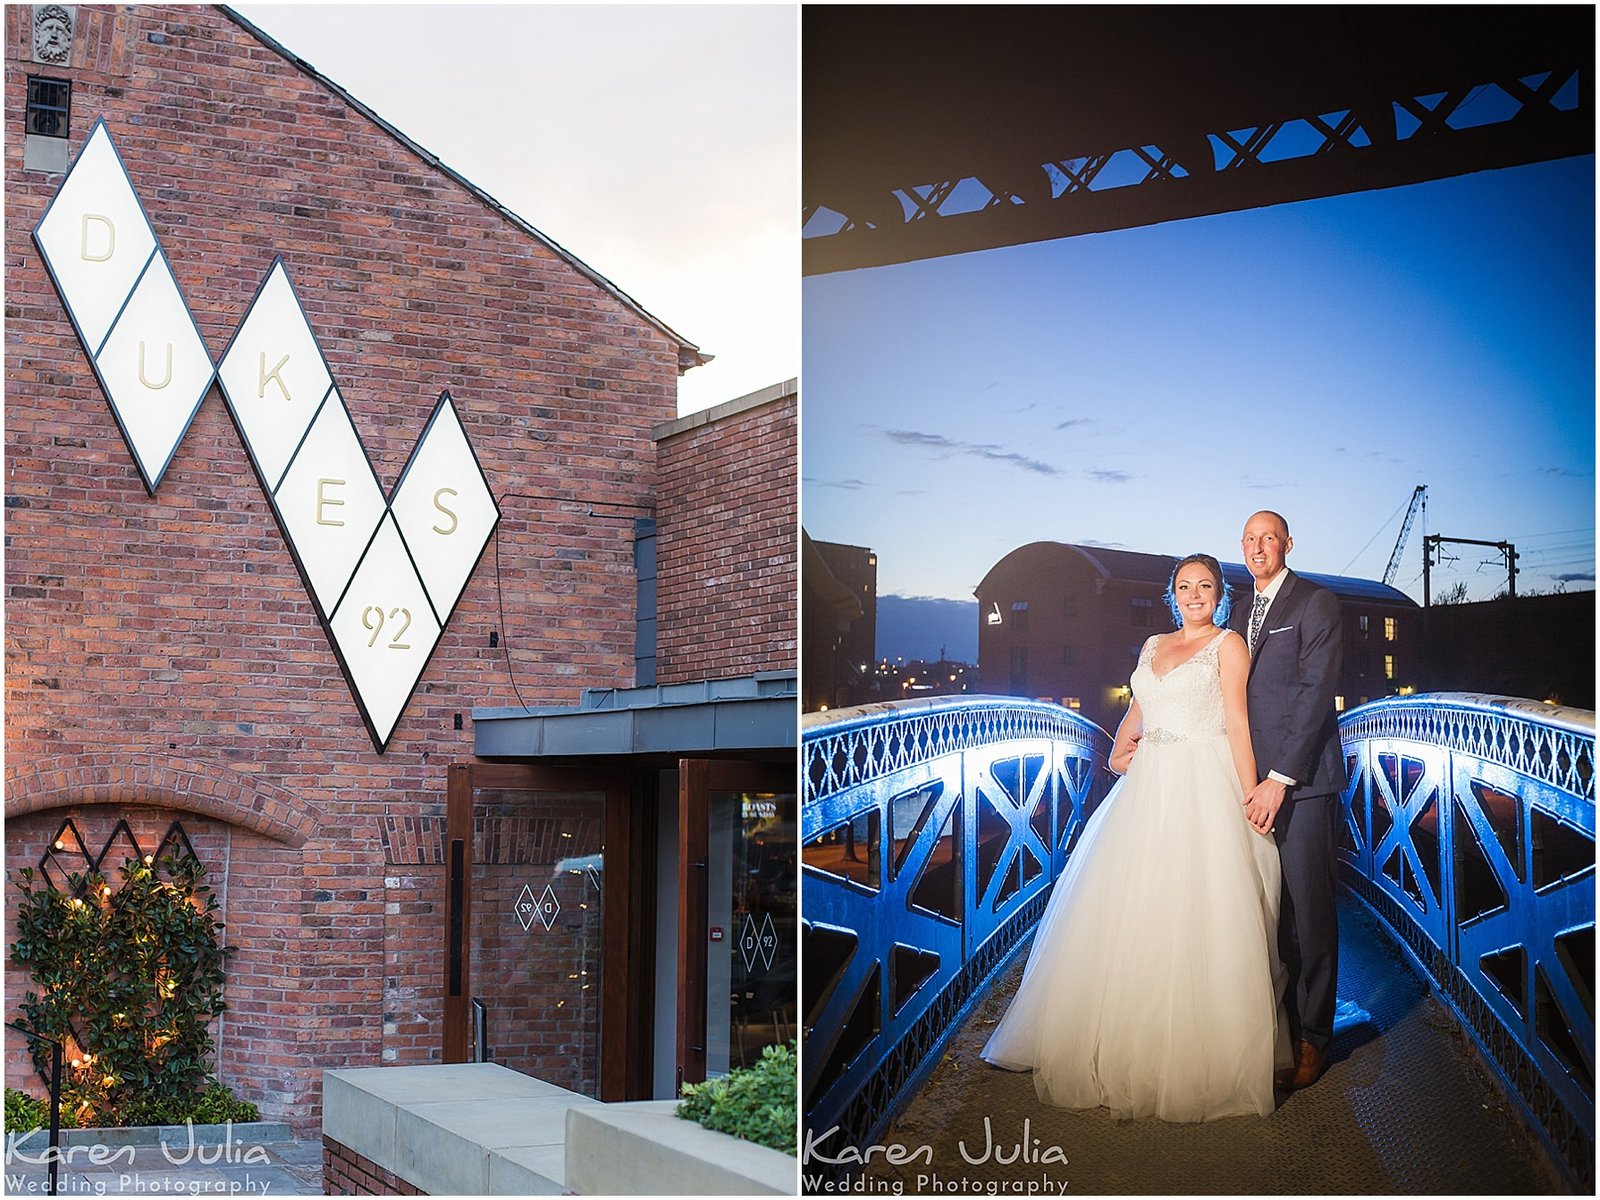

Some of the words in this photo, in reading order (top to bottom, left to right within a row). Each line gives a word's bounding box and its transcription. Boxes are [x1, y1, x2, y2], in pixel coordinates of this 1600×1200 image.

[361, 605, 412, 650] 92
[746, 936, 753, 949] D
[763, 935, 773, 947] 92
